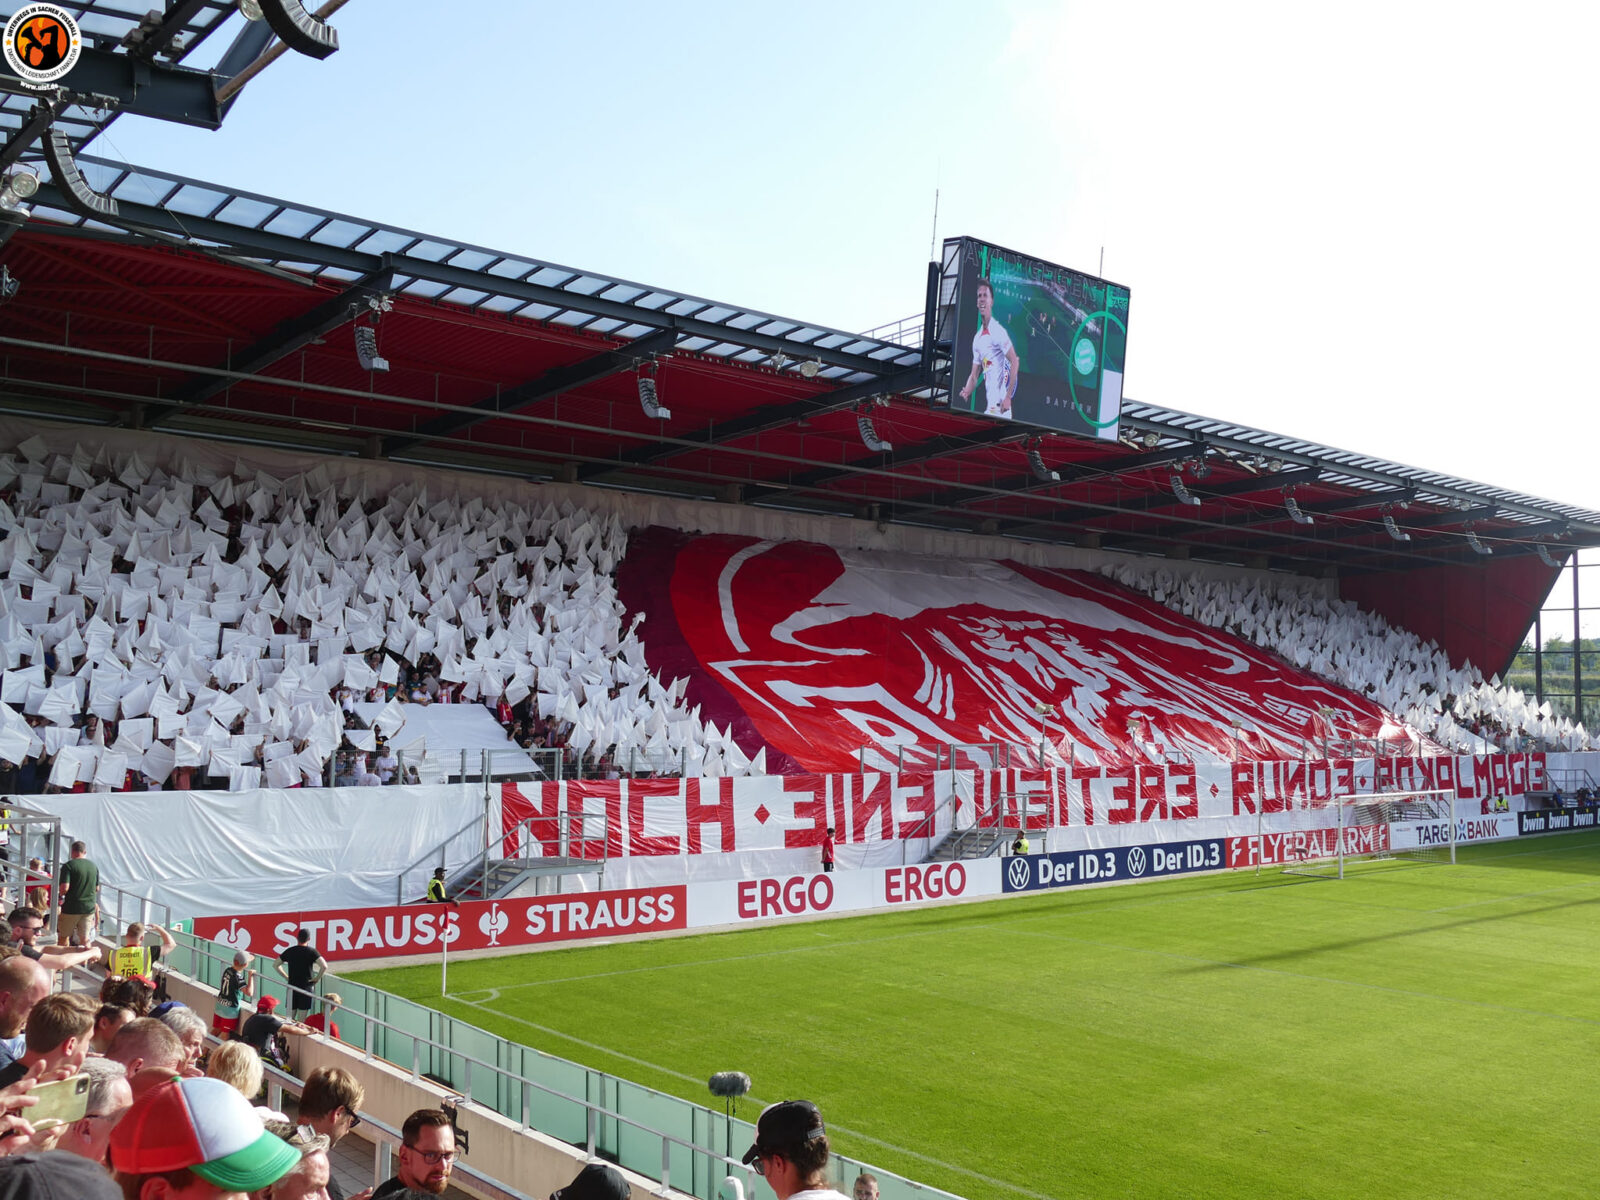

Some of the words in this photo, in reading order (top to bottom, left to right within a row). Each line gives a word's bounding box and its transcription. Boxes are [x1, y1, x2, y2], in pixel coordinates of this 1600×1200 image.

[501, 776, 736, 860] NOCH
[784, 770, 936, 848] EINE
[1231, 757, 1354, 815] RUNDE
[1523, 812, 1545, 832] bwin
[1549, 810, 1570, 829] bwin
[1573, 807, 1594, 826] bwin
[1038, 858, 1074, 884] Der
[1079, 851, 1116, 879] ID.3
[1153, 848, 1183, 872] Der
[1187, 842, 1220, 868] ID.3
[738, 873, 834, 919] ERGO
[885, 861, 967, 903] ERGO
[273, 911, 461, 955] STRAUSS
[525, 893, 675, 936] STRAUSS
